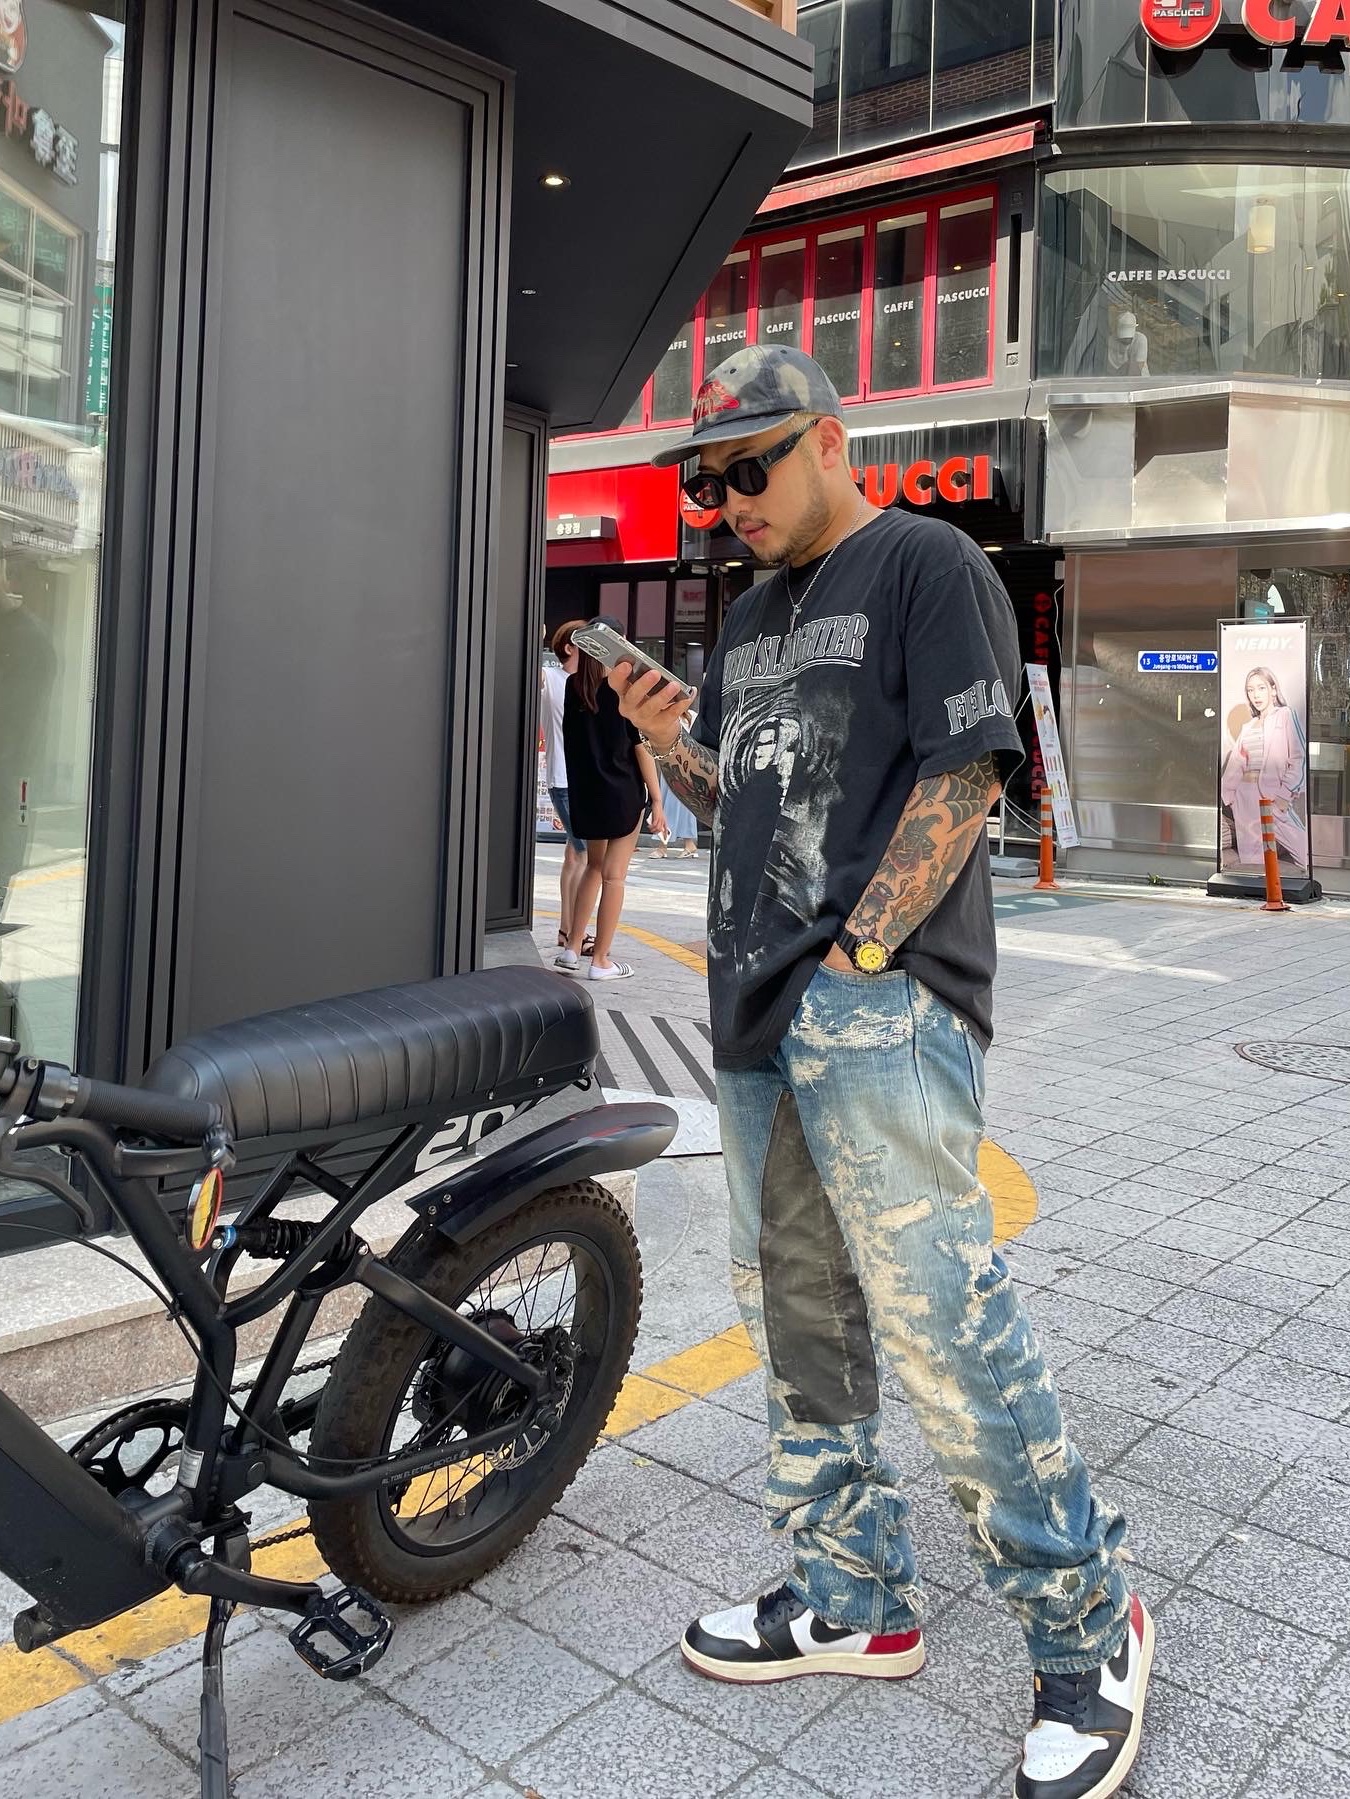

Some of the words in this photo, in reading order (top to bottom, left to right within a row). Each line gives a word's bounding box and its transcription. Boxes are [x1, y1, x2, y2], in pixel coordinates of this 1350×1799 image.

[1152, 8, 1205, 17] PASCUCCI
[1107, 270, 1152, 281] CAFFE
[1157, 269, 1231, 280] PASCUCCI
[883, 300, 914, 313] CAFFE
[937, 286, 989, 304] PASCUCCI
[766, 321, 794, 333] CAFFE
[814, 309, 860, 326] PASCUCCI
[667, 340, 687, 351] AFFE
[704, 329, 746, 345] PASCUCCI
[851, 455, 992, 508] UCCI
[1158, 654, 1198, 664] 중앙로160번길
[1207, 658, 1216, 666] 17
